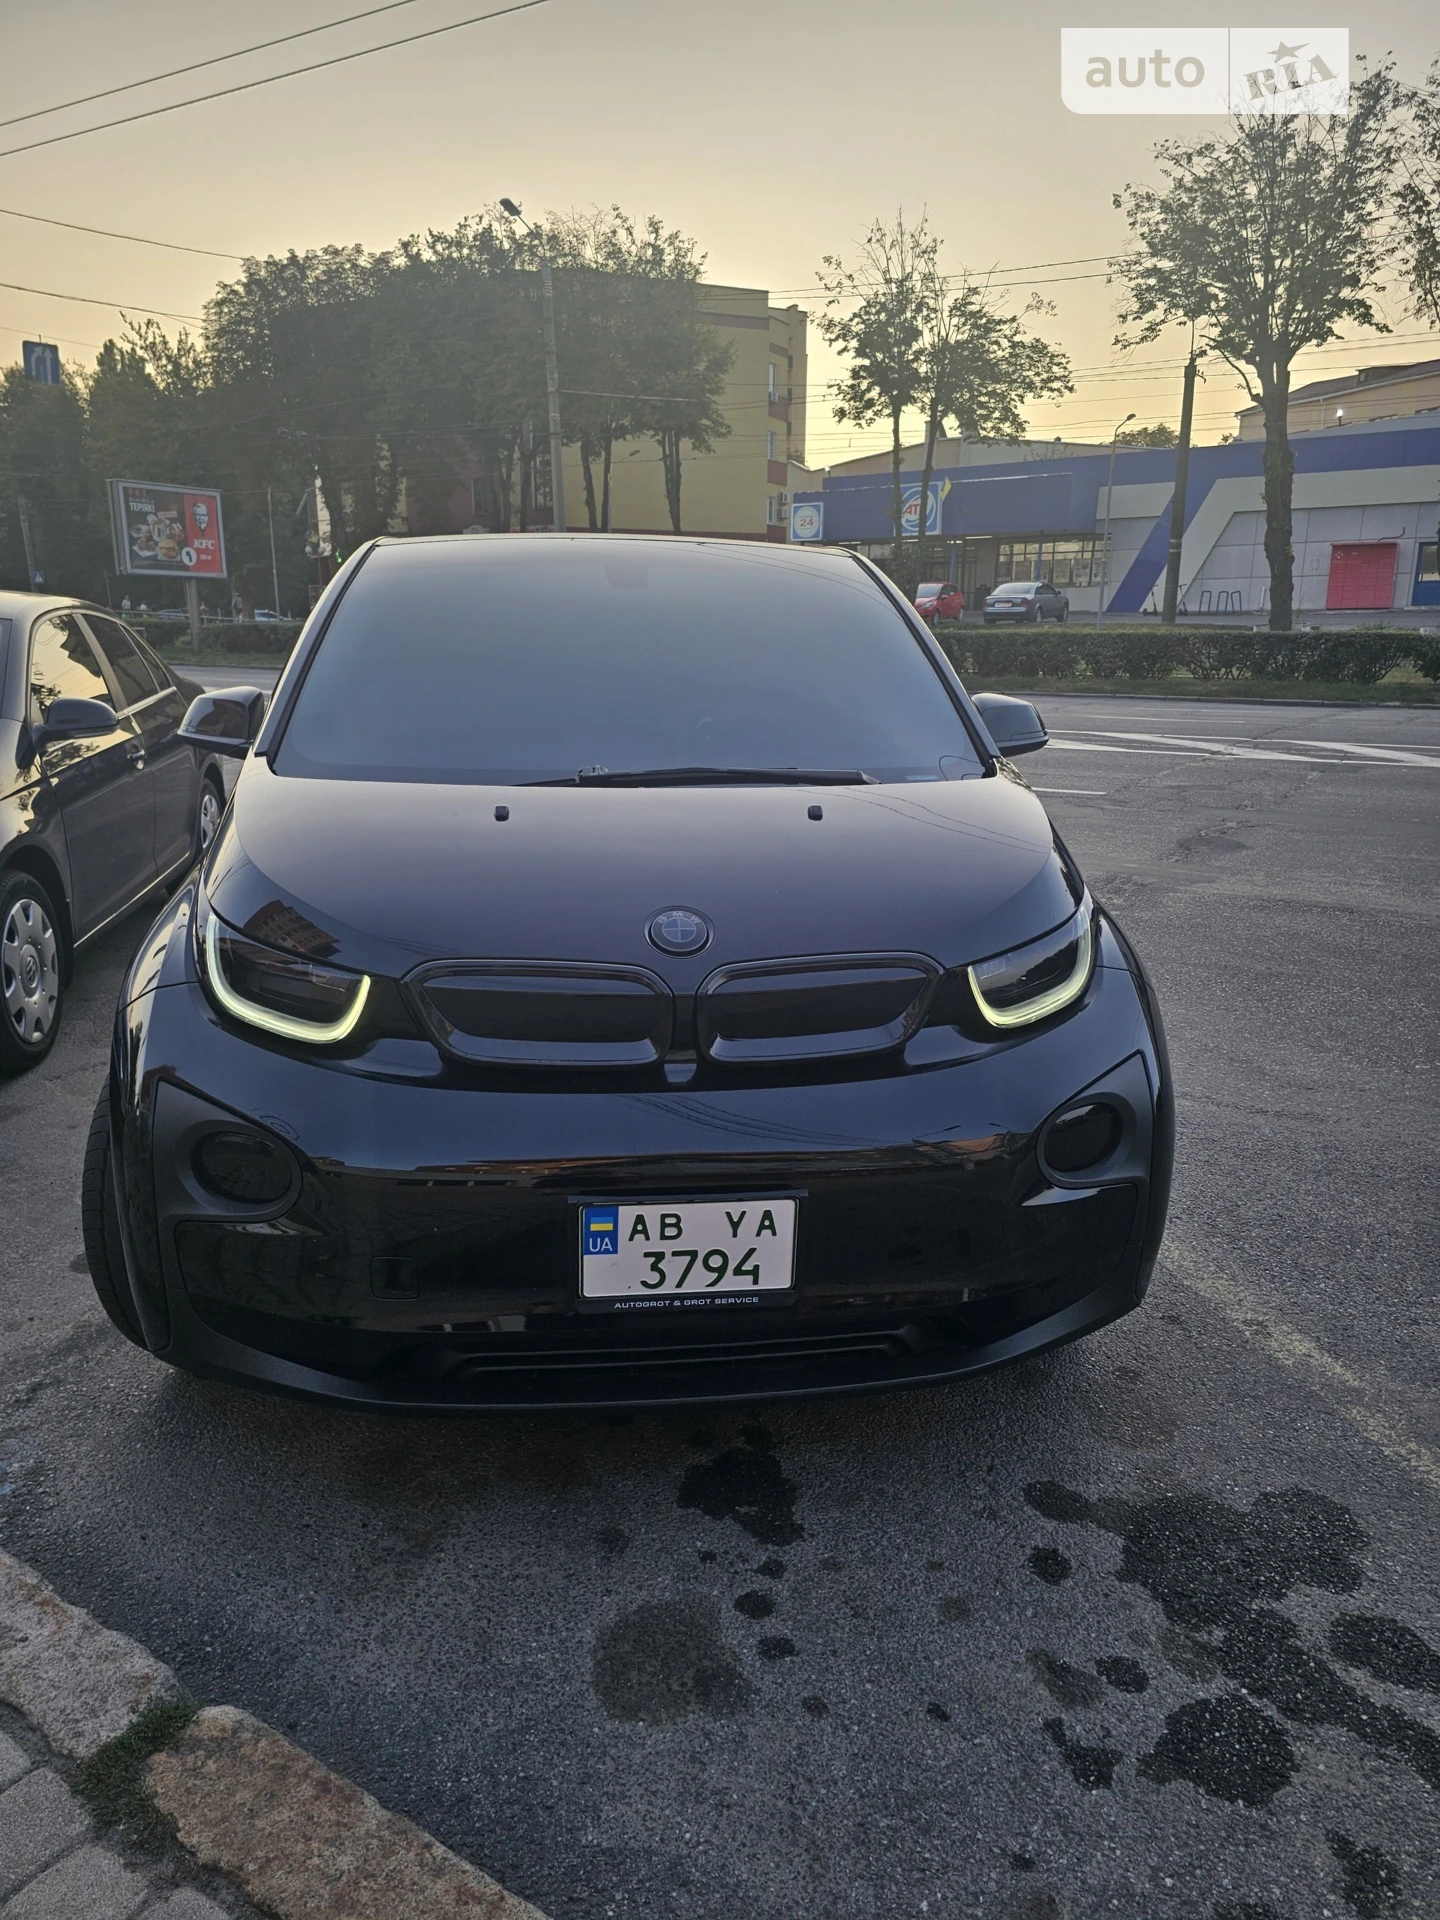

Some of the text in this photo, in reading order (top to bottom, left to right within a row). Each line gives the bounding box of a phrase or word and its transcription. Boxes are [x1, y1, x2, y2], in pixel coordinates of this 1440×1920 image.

[799, 518, 814, 527] 24
[193, 539, 215, 550] KFC
[656, 911, 701, 924] BMW
[628, 1209, 777, 1242] AB YA
[589, 1237, 613, 1252] UA
[640, 1247, 760, 1289] 3794
[614, 1300, 670, 1309] AUTOGROT
[714, 1296, 759, 1305] SERVICE
